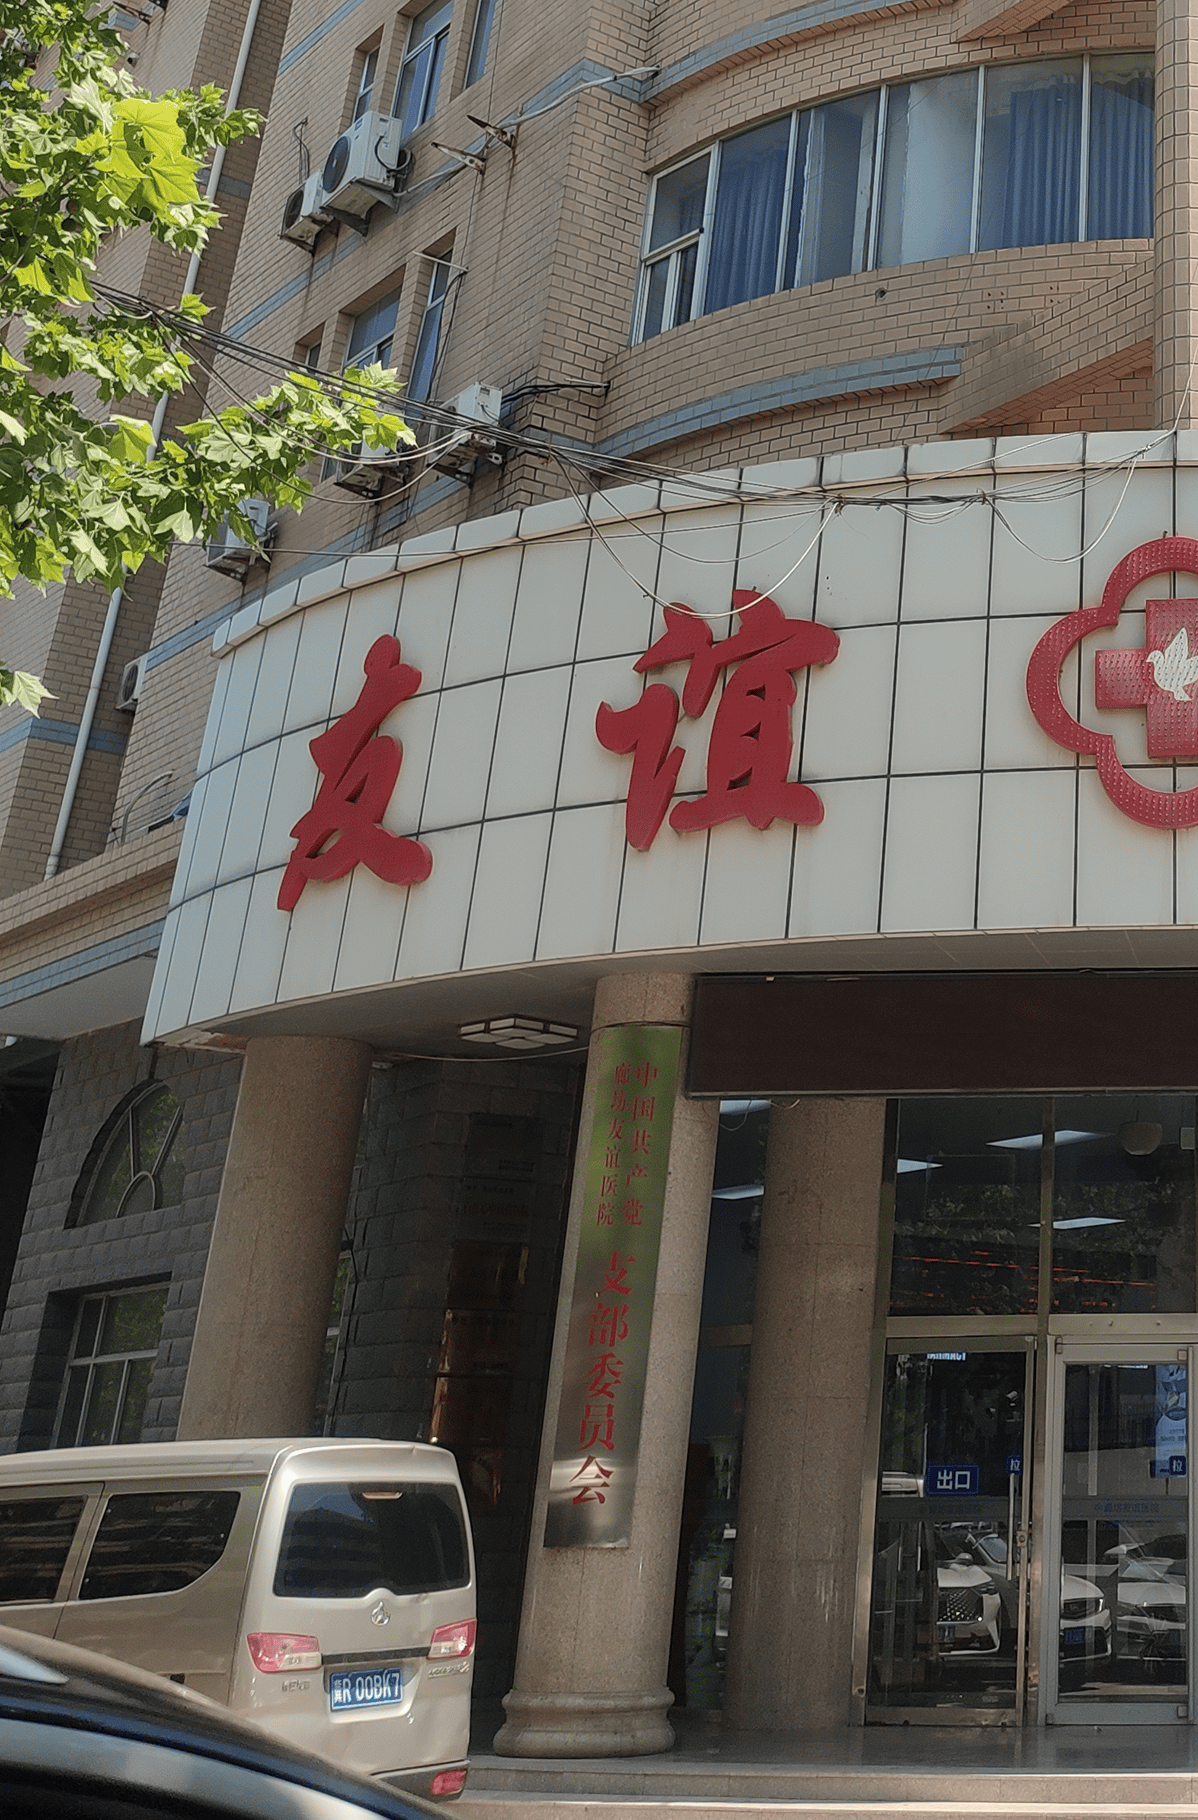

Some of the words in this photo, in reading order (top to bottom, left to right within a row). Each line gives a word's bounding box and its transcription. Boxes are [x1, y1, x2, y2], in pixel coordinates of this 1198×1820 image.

[277, 589, 840, 912] 友谊
[596, 1062, 630, 1226] 廊坊友谊医院
[622, 1061, 658, 1226] 中国共产党
[570, 1250, 636, 1505] 支部委员会
[936, 1469, 971, 1490] 出口
[1010, 1458, 1020, 1471] 拉
[1172, 1459, 1183, 1472] 拉
